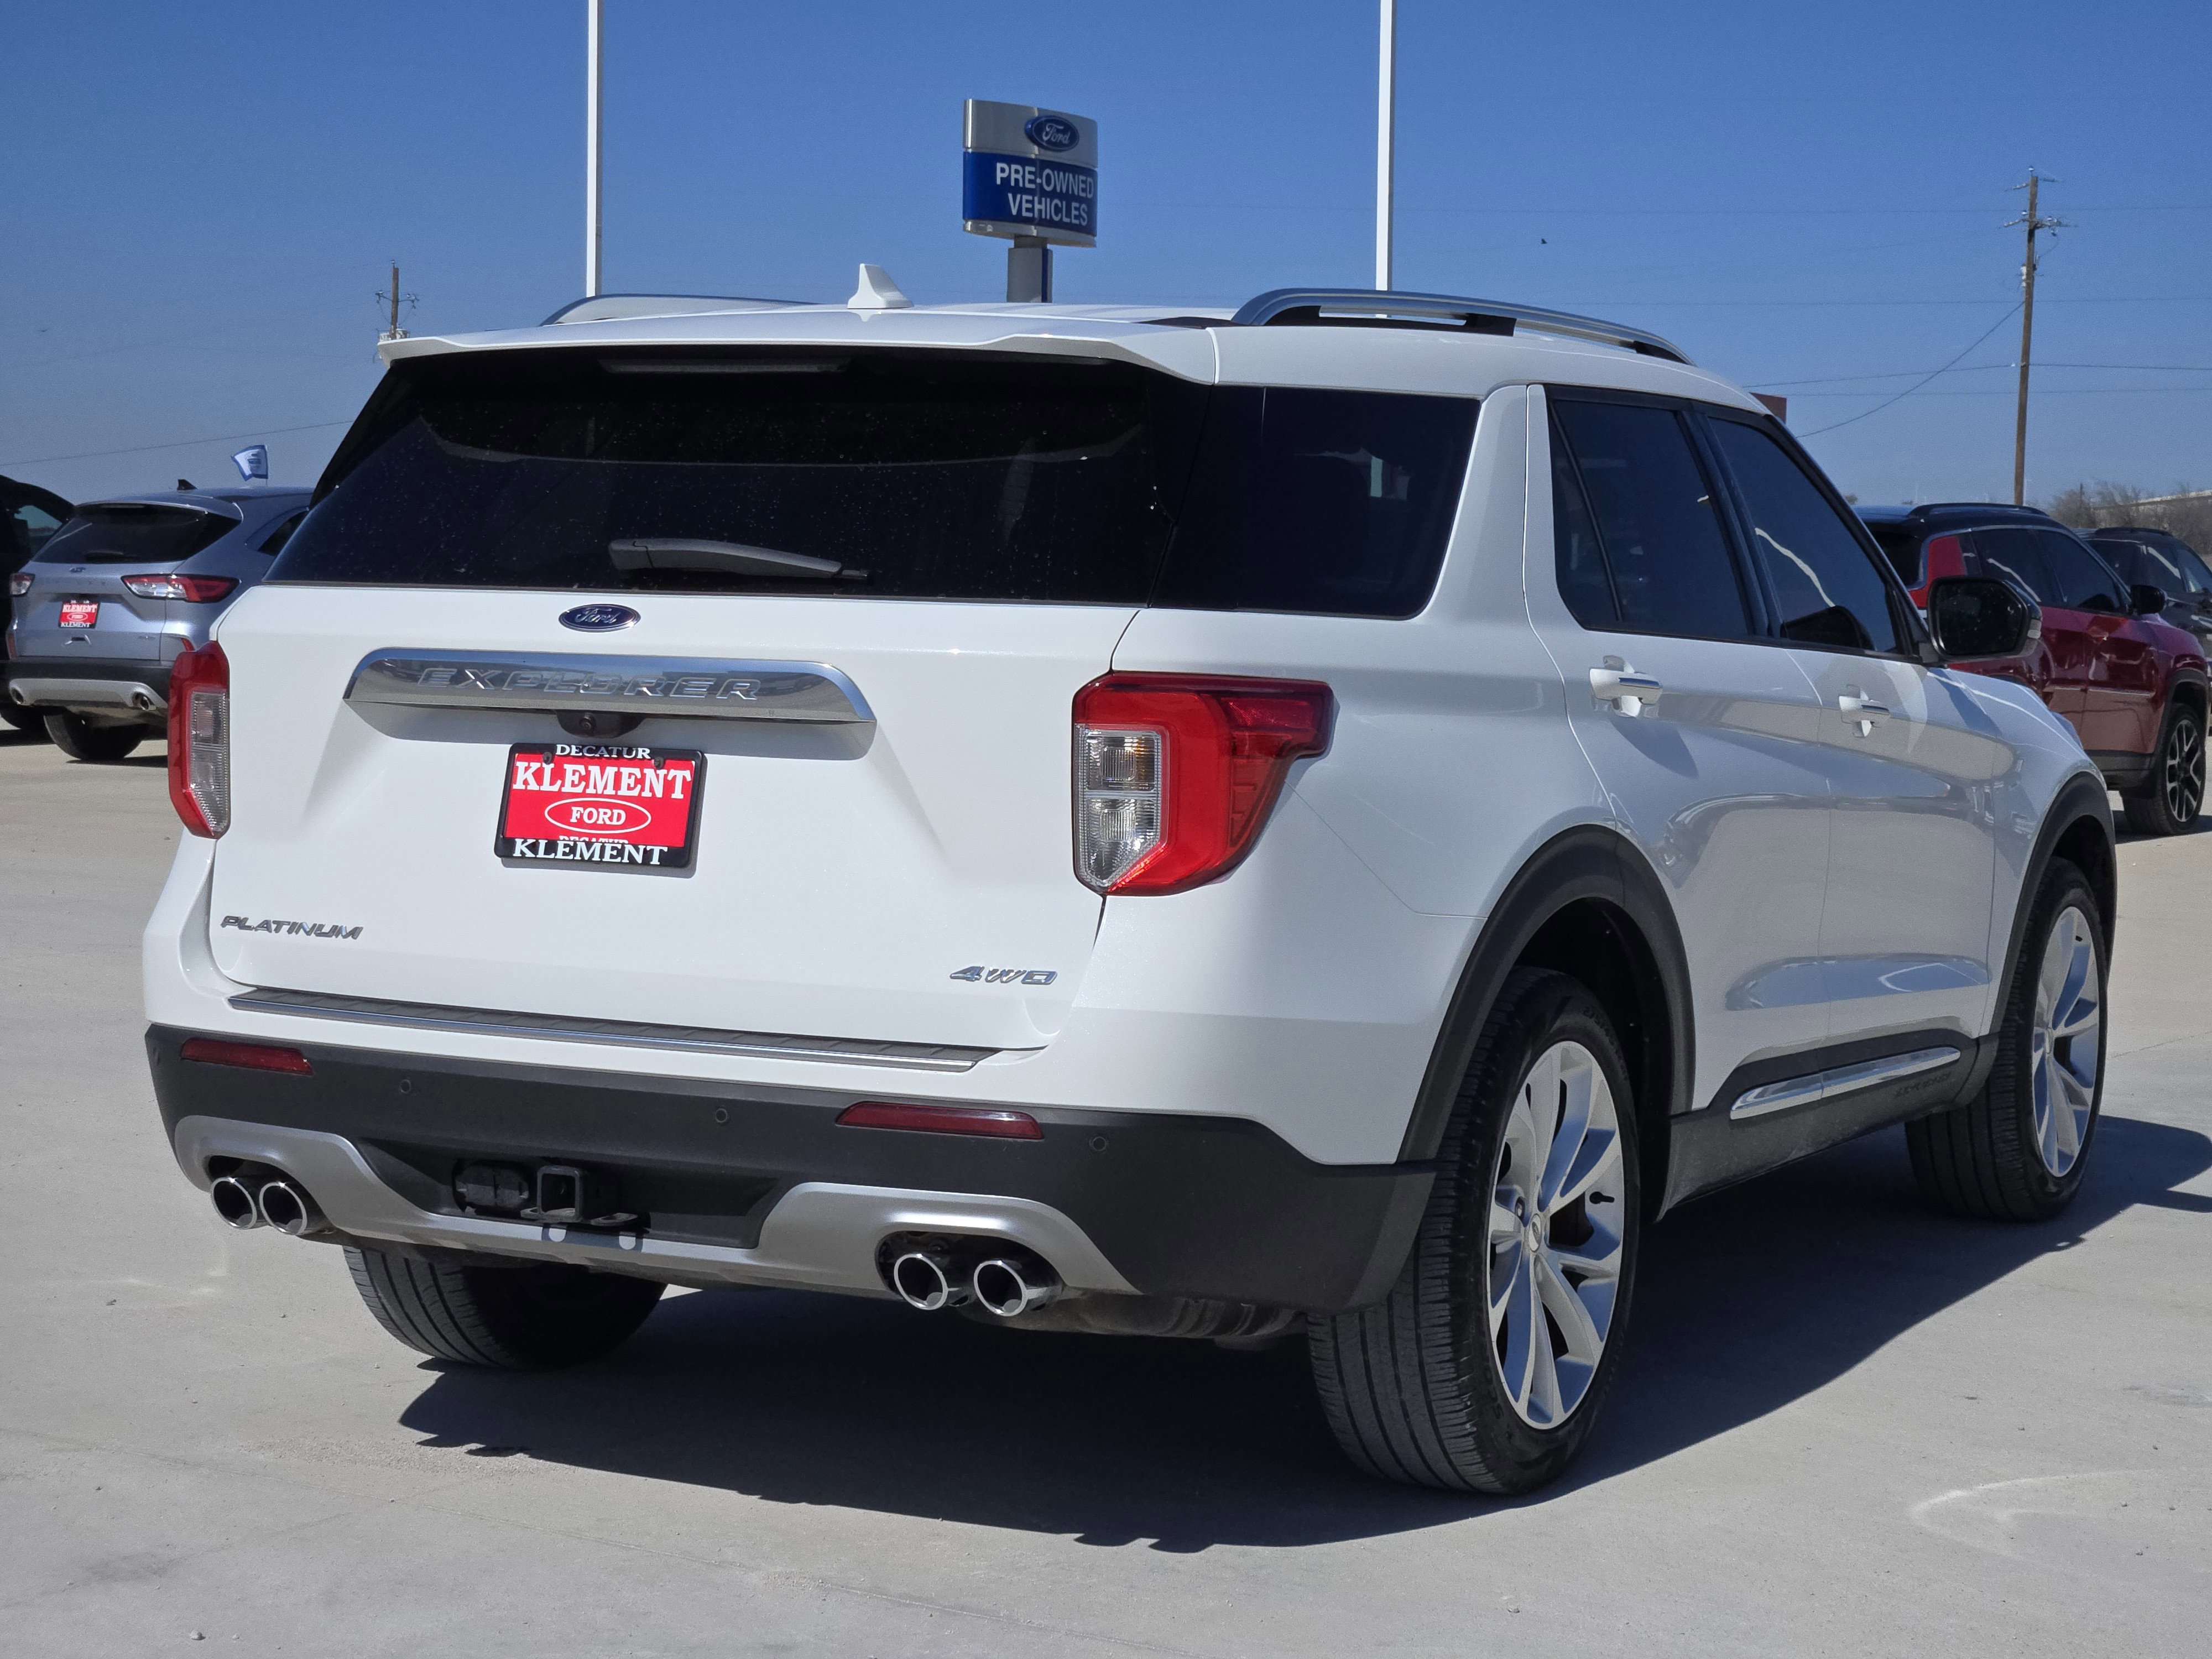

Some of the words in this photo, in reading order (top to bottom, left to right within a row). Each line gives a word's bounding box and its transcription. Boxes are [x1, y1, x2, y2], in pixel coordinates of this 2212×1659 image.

[1042, 123, 1071, 144] Ford
[996, 162, 1094, 199] PRE-OWNED
[1008, 193, 1088, 226] VEHICLES
[62, 604, 97, 613] KLEMENT
[575, 607, 622, 624] Ford
[417, 667, 764, 701] EXPLORER
[555, 744, 651, 759] DECATUR
[513, 760, 692, 799] KLEMENT
[570, 806, 626, 825] FORD
[513, 838, 668, 865] KLEMENT
[221, 915, 364, 940] PLATINUM
[949, 966, 1058, 985] 4WD
